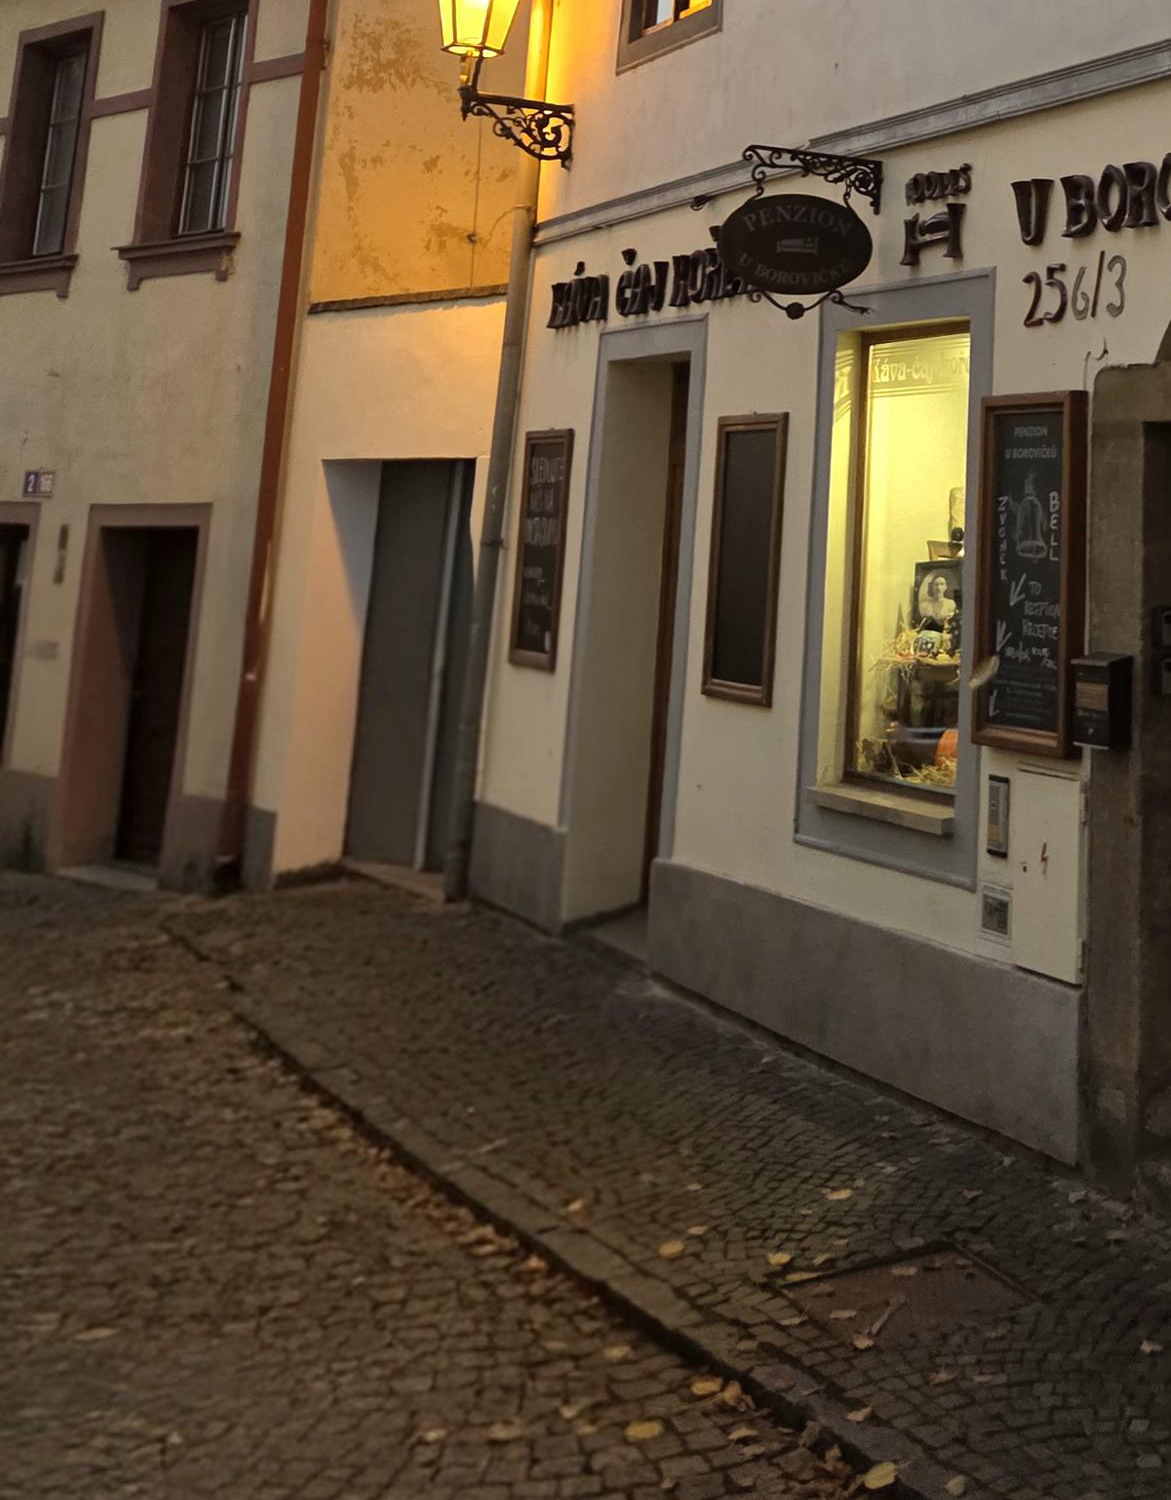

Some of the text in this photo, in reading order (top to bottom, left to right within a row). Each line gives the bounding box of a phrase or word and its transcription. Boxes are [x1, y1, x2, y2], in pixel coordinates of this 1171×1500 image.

[742, 204, 852, 238] PENZION
[1010, 178, 1054, 246] U
[1022, 250, 1127, 328] 256/3
[1048, 491, 1060, 562] BELL
